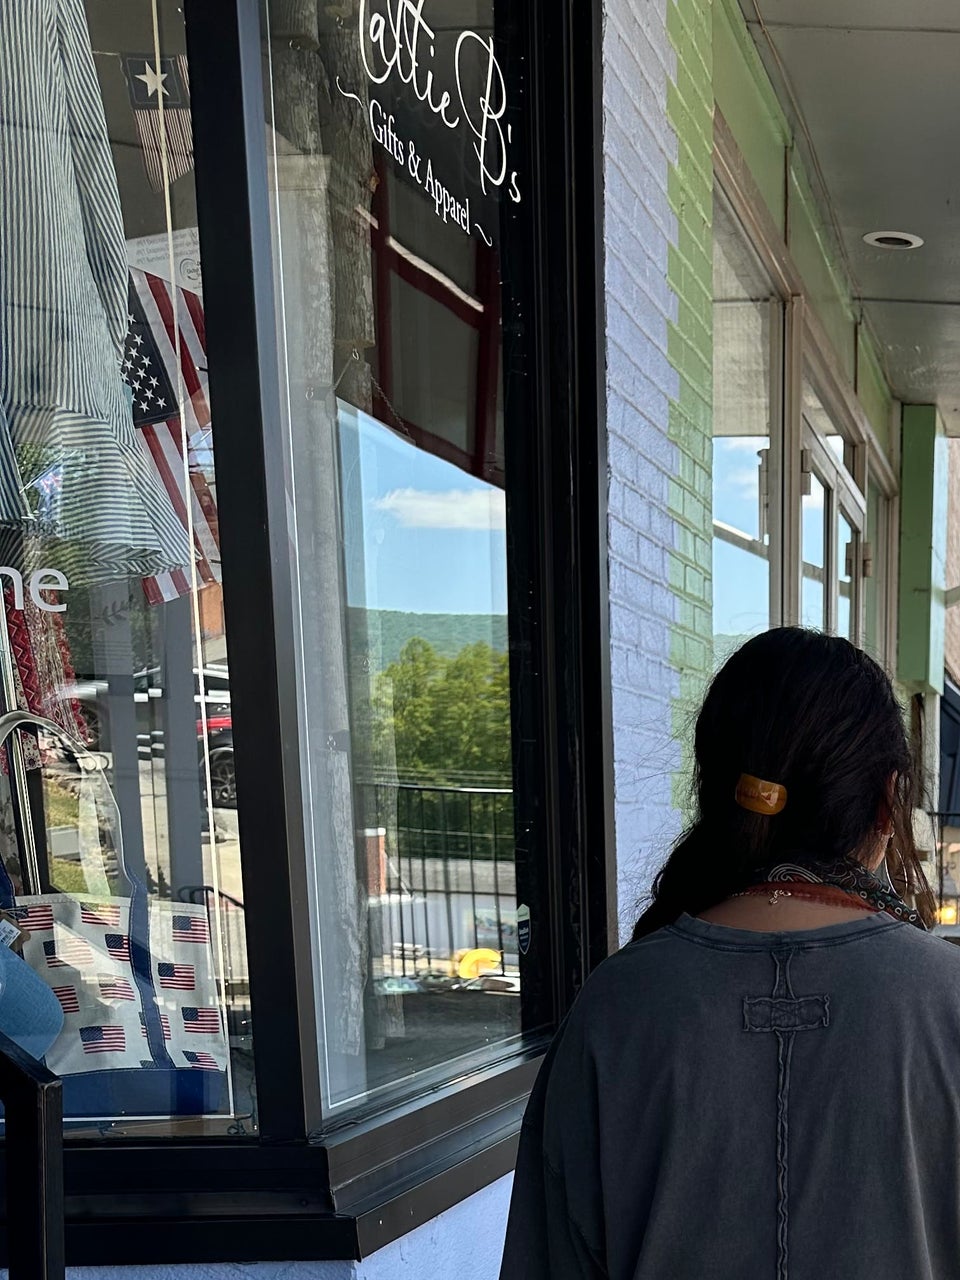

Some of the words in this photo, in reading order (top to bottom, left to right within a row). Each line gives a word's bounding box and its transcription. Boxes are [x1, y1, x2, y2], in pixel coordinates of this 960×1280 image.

[369, 99, 405, 166] Gifts
[408, 140, 423, 185] &
[424, 157, 472, 236] Apparel
[455, 30, 522, 204] B's
